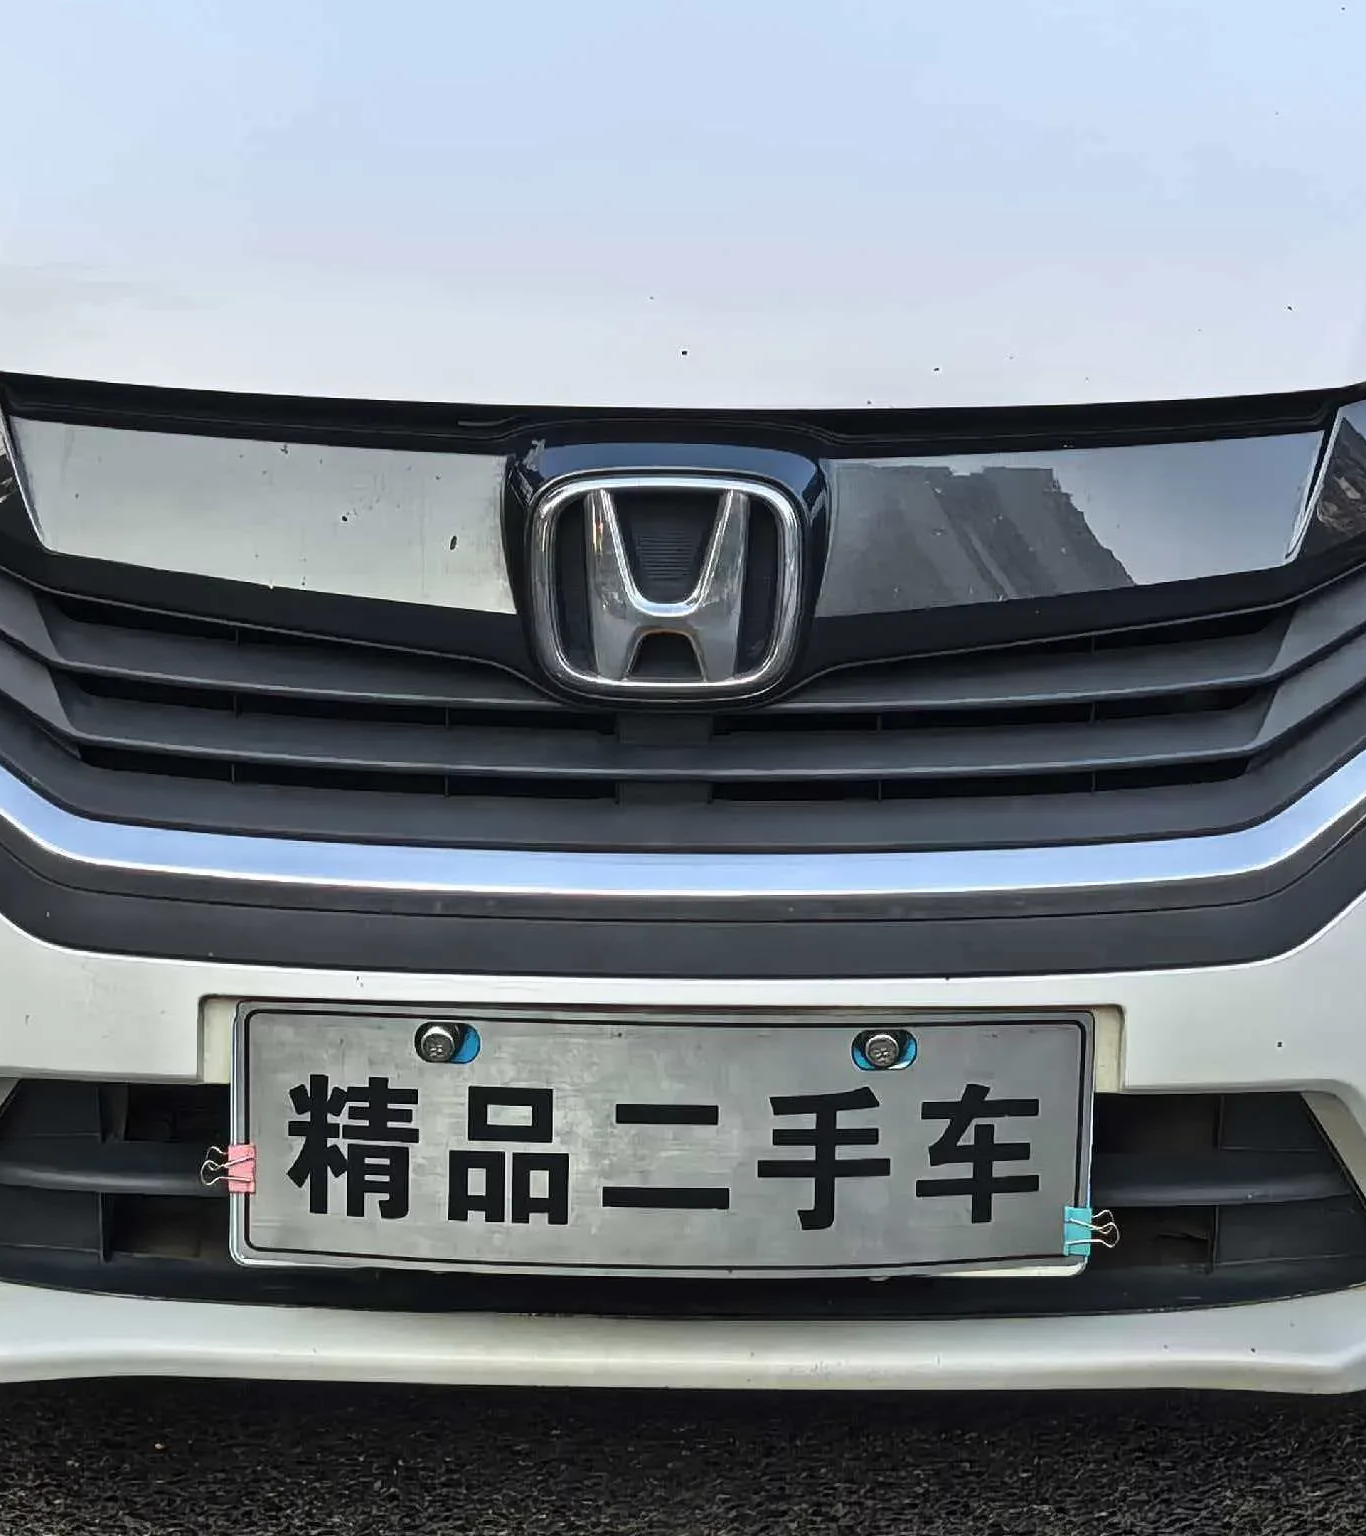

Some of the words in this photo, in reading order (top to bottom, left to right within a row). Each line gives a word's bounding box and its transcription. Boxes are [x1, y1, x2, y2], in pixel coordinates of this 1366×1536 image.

[287, 1074, 1040, 1231] 精品二手车
